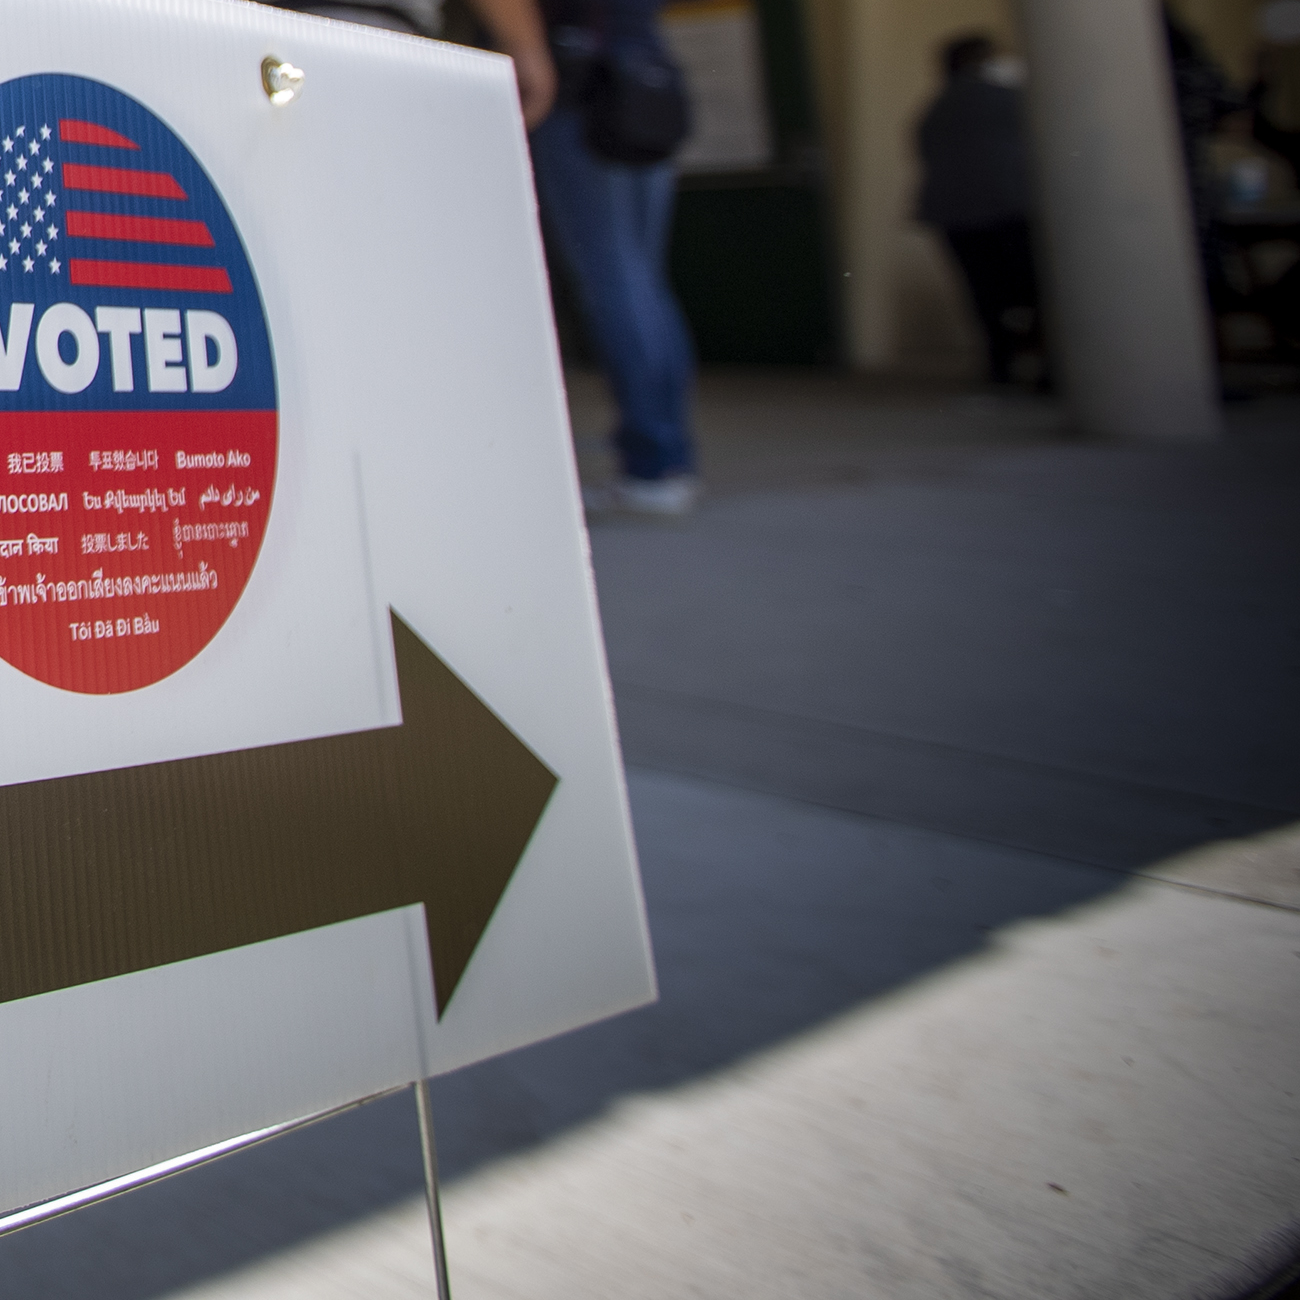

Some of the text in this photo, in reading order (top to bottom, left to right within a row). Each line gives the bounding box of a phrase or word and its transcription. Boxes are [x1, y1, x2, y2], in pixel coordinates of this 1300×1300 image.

[7, 451, 64, 475] 我已投票
[89, 449, 159, 472] 투표했습니다
[175, 449, 251, 470] Bumoto Ako
[27, 533, 59, 555] किया
[82, 531, 149, 554] 投票しました
[69, 621, 92, 641] Tôi
[116, 617, 131, 637] Đi
